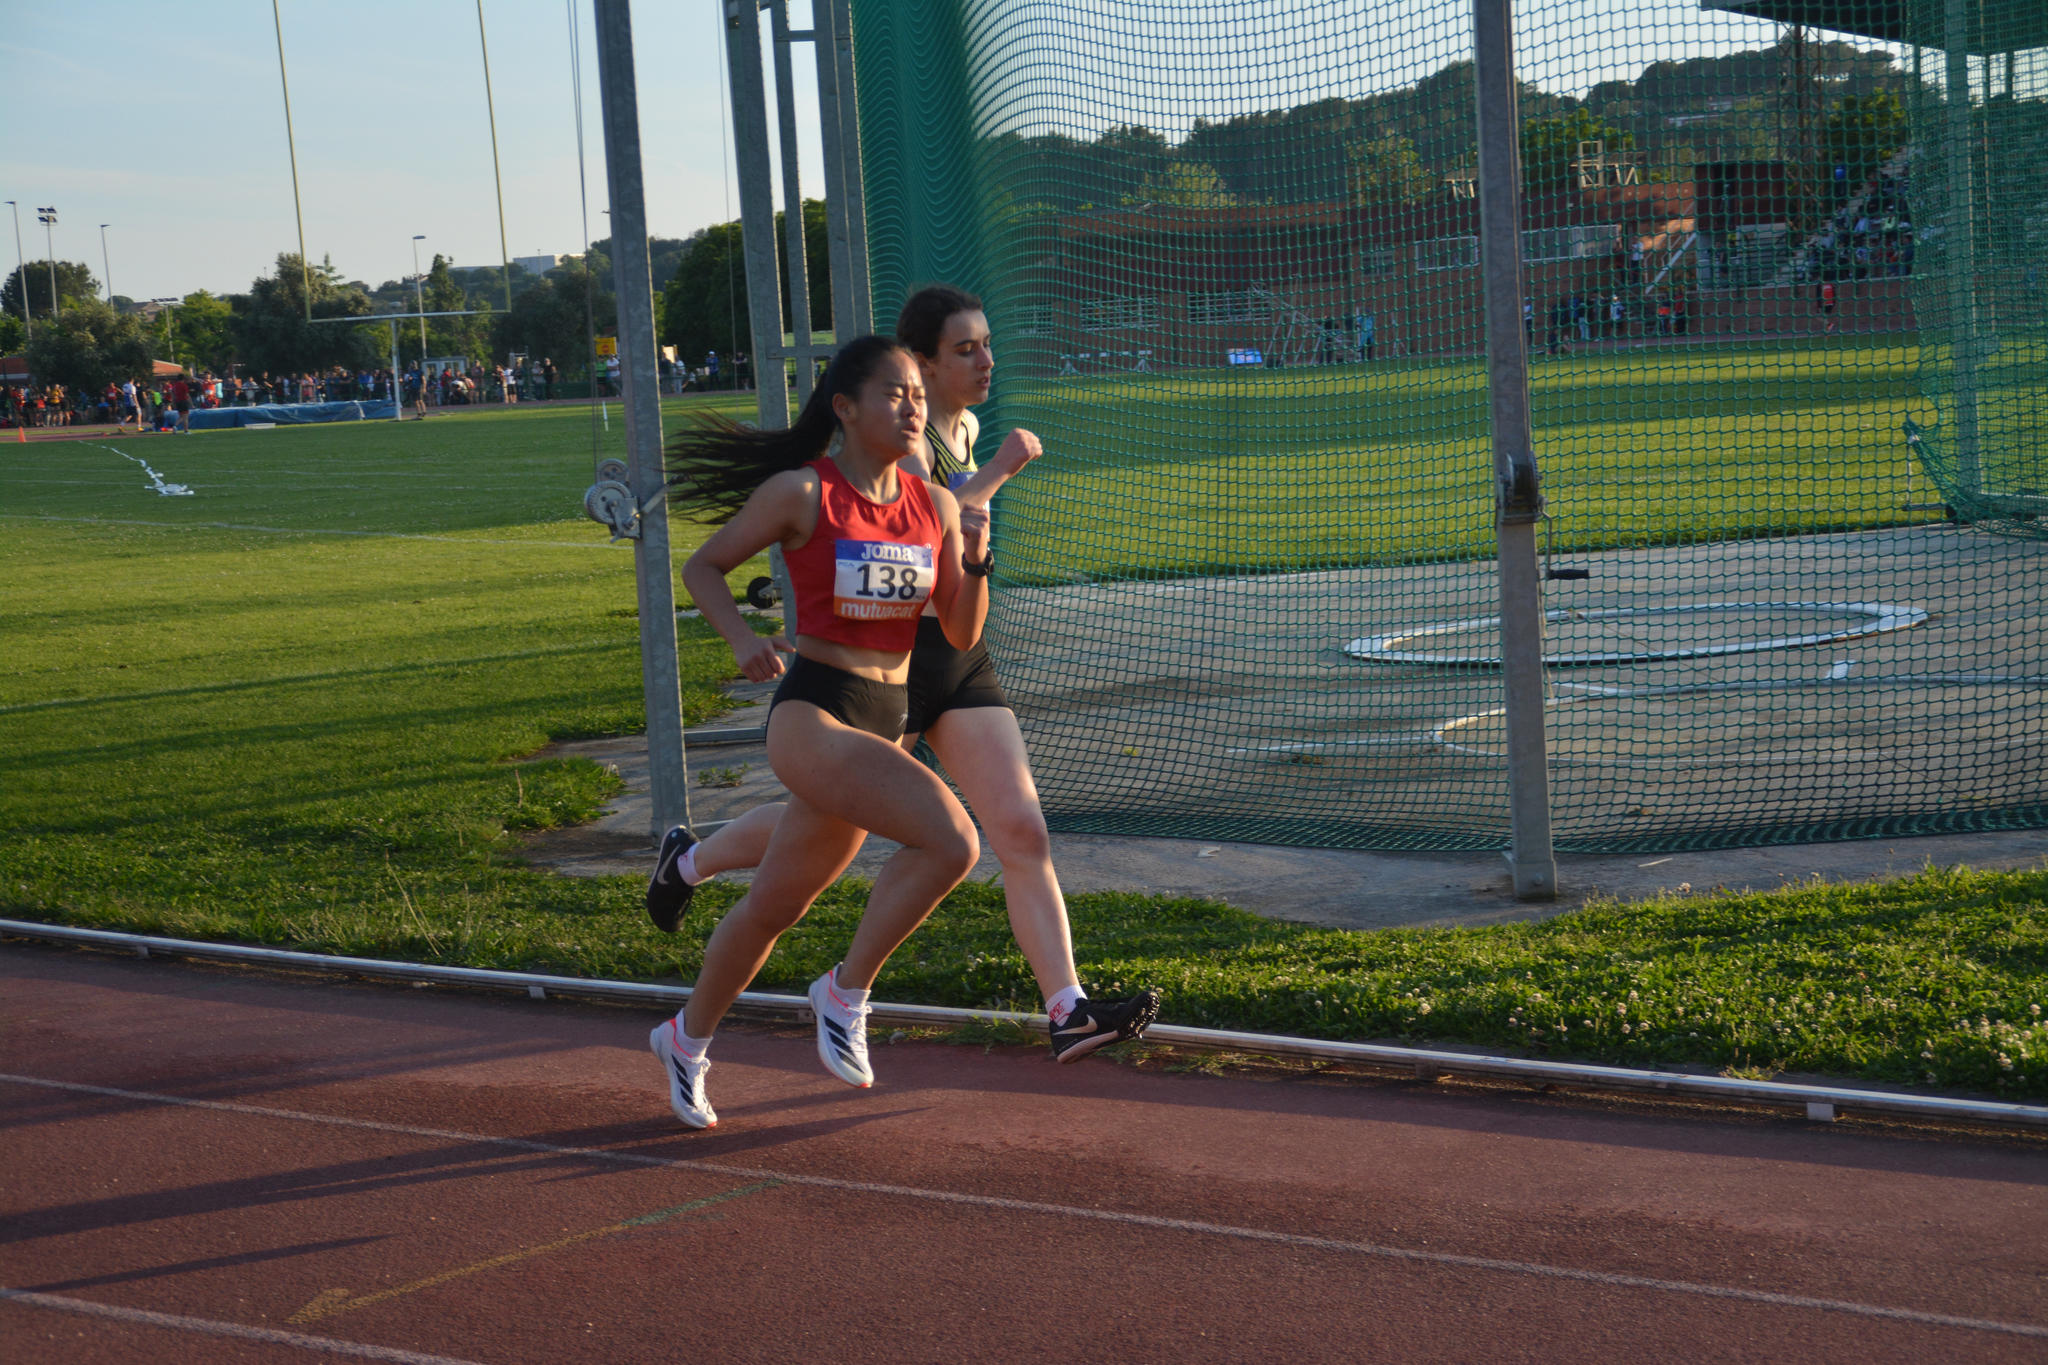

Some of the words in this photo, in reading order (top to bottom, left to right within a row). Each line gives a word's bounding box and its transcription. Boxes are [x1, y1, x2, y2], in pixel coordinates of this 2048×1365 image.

[861, 543, 914, 562] Joma
[856, 563, 918, 600] 138
[841, 602, 916, 618] mutuacat
